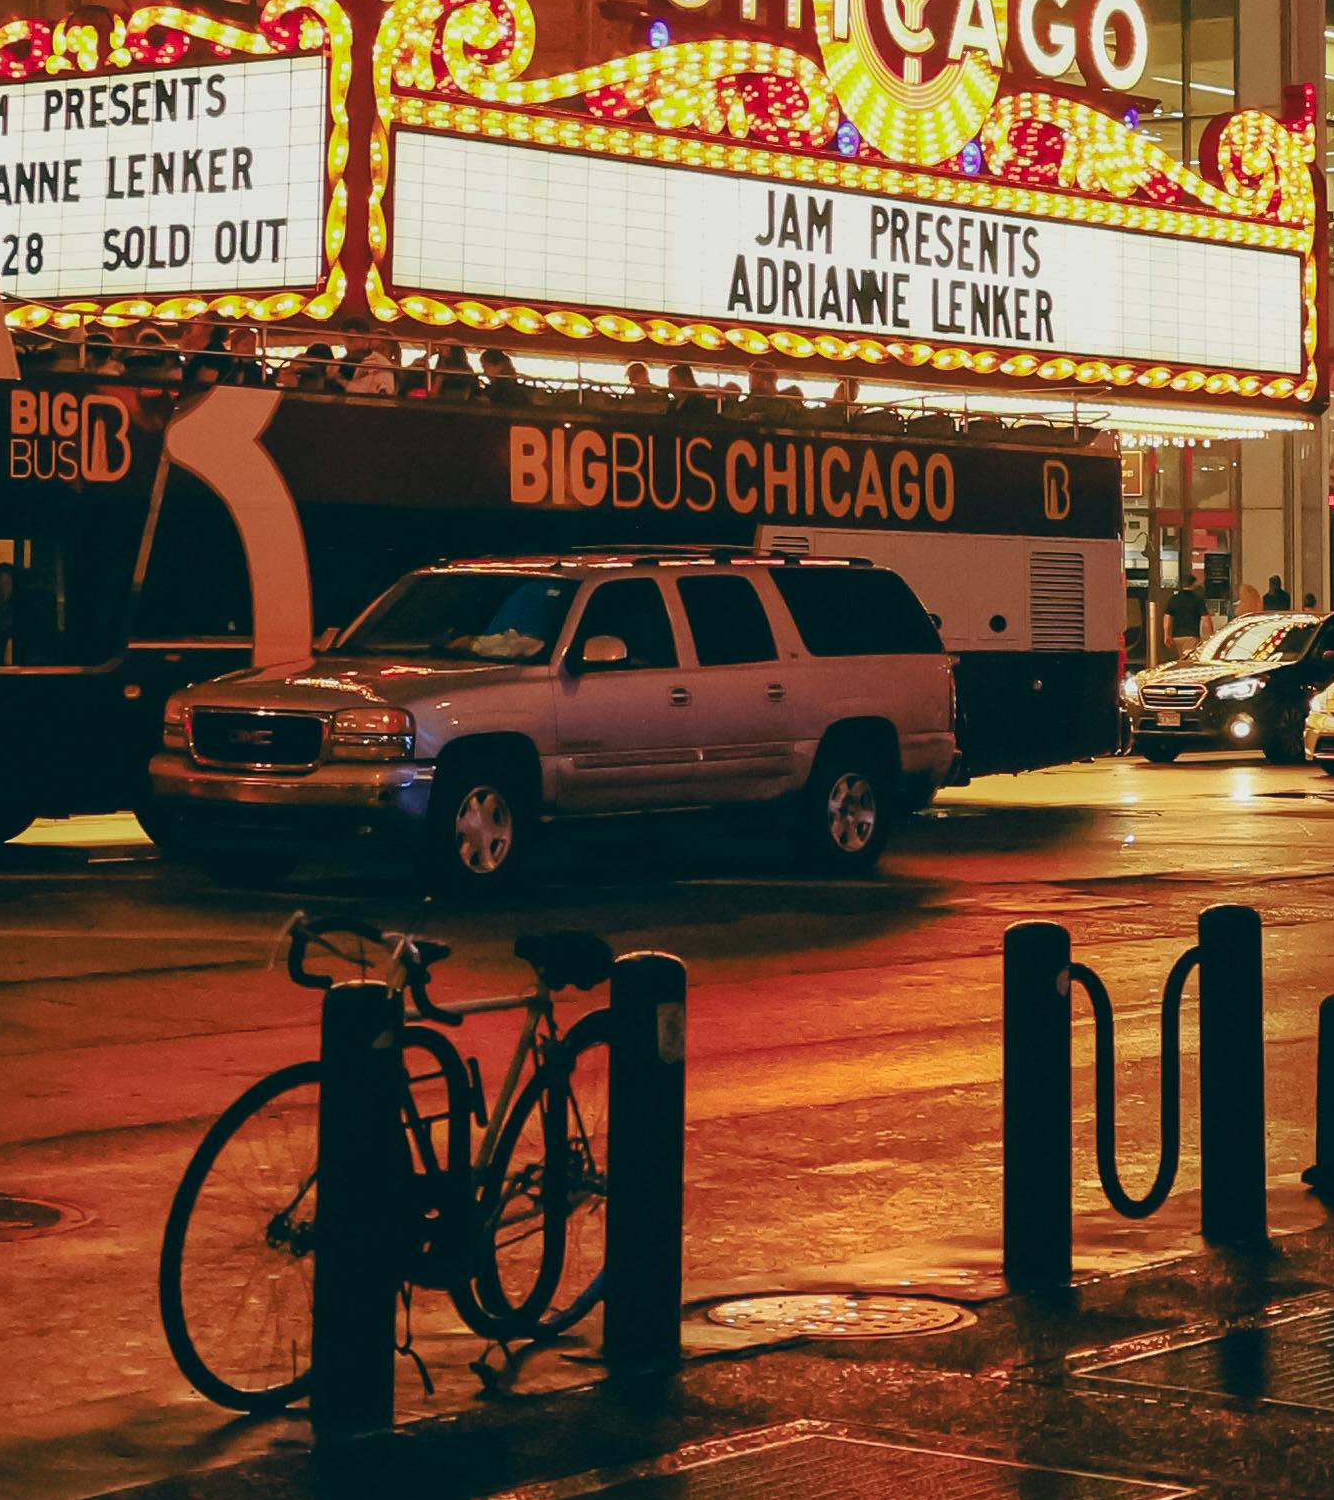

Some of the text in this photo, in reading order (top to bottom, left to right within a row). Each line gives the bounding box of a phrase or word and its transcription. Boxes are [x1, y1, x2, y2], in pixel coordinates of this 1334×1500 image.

[43, 74, 226, 132] PRESENTS
[107, 147, 254, 199] LENKER
[3, 233, 43, 276] 28
[103, 224, 190, 271] SOLD
[216, 218, 287, 264] OUT
[755, 190, 1041, 278] JAM PRESENTS
[728, 254, 1055, 342] ADRIANNE LENKER
[10, 391, 78, 437] BIG
[9, 439, 78, 480] BUS
[724, 439, 954, 522] CHICAGO
